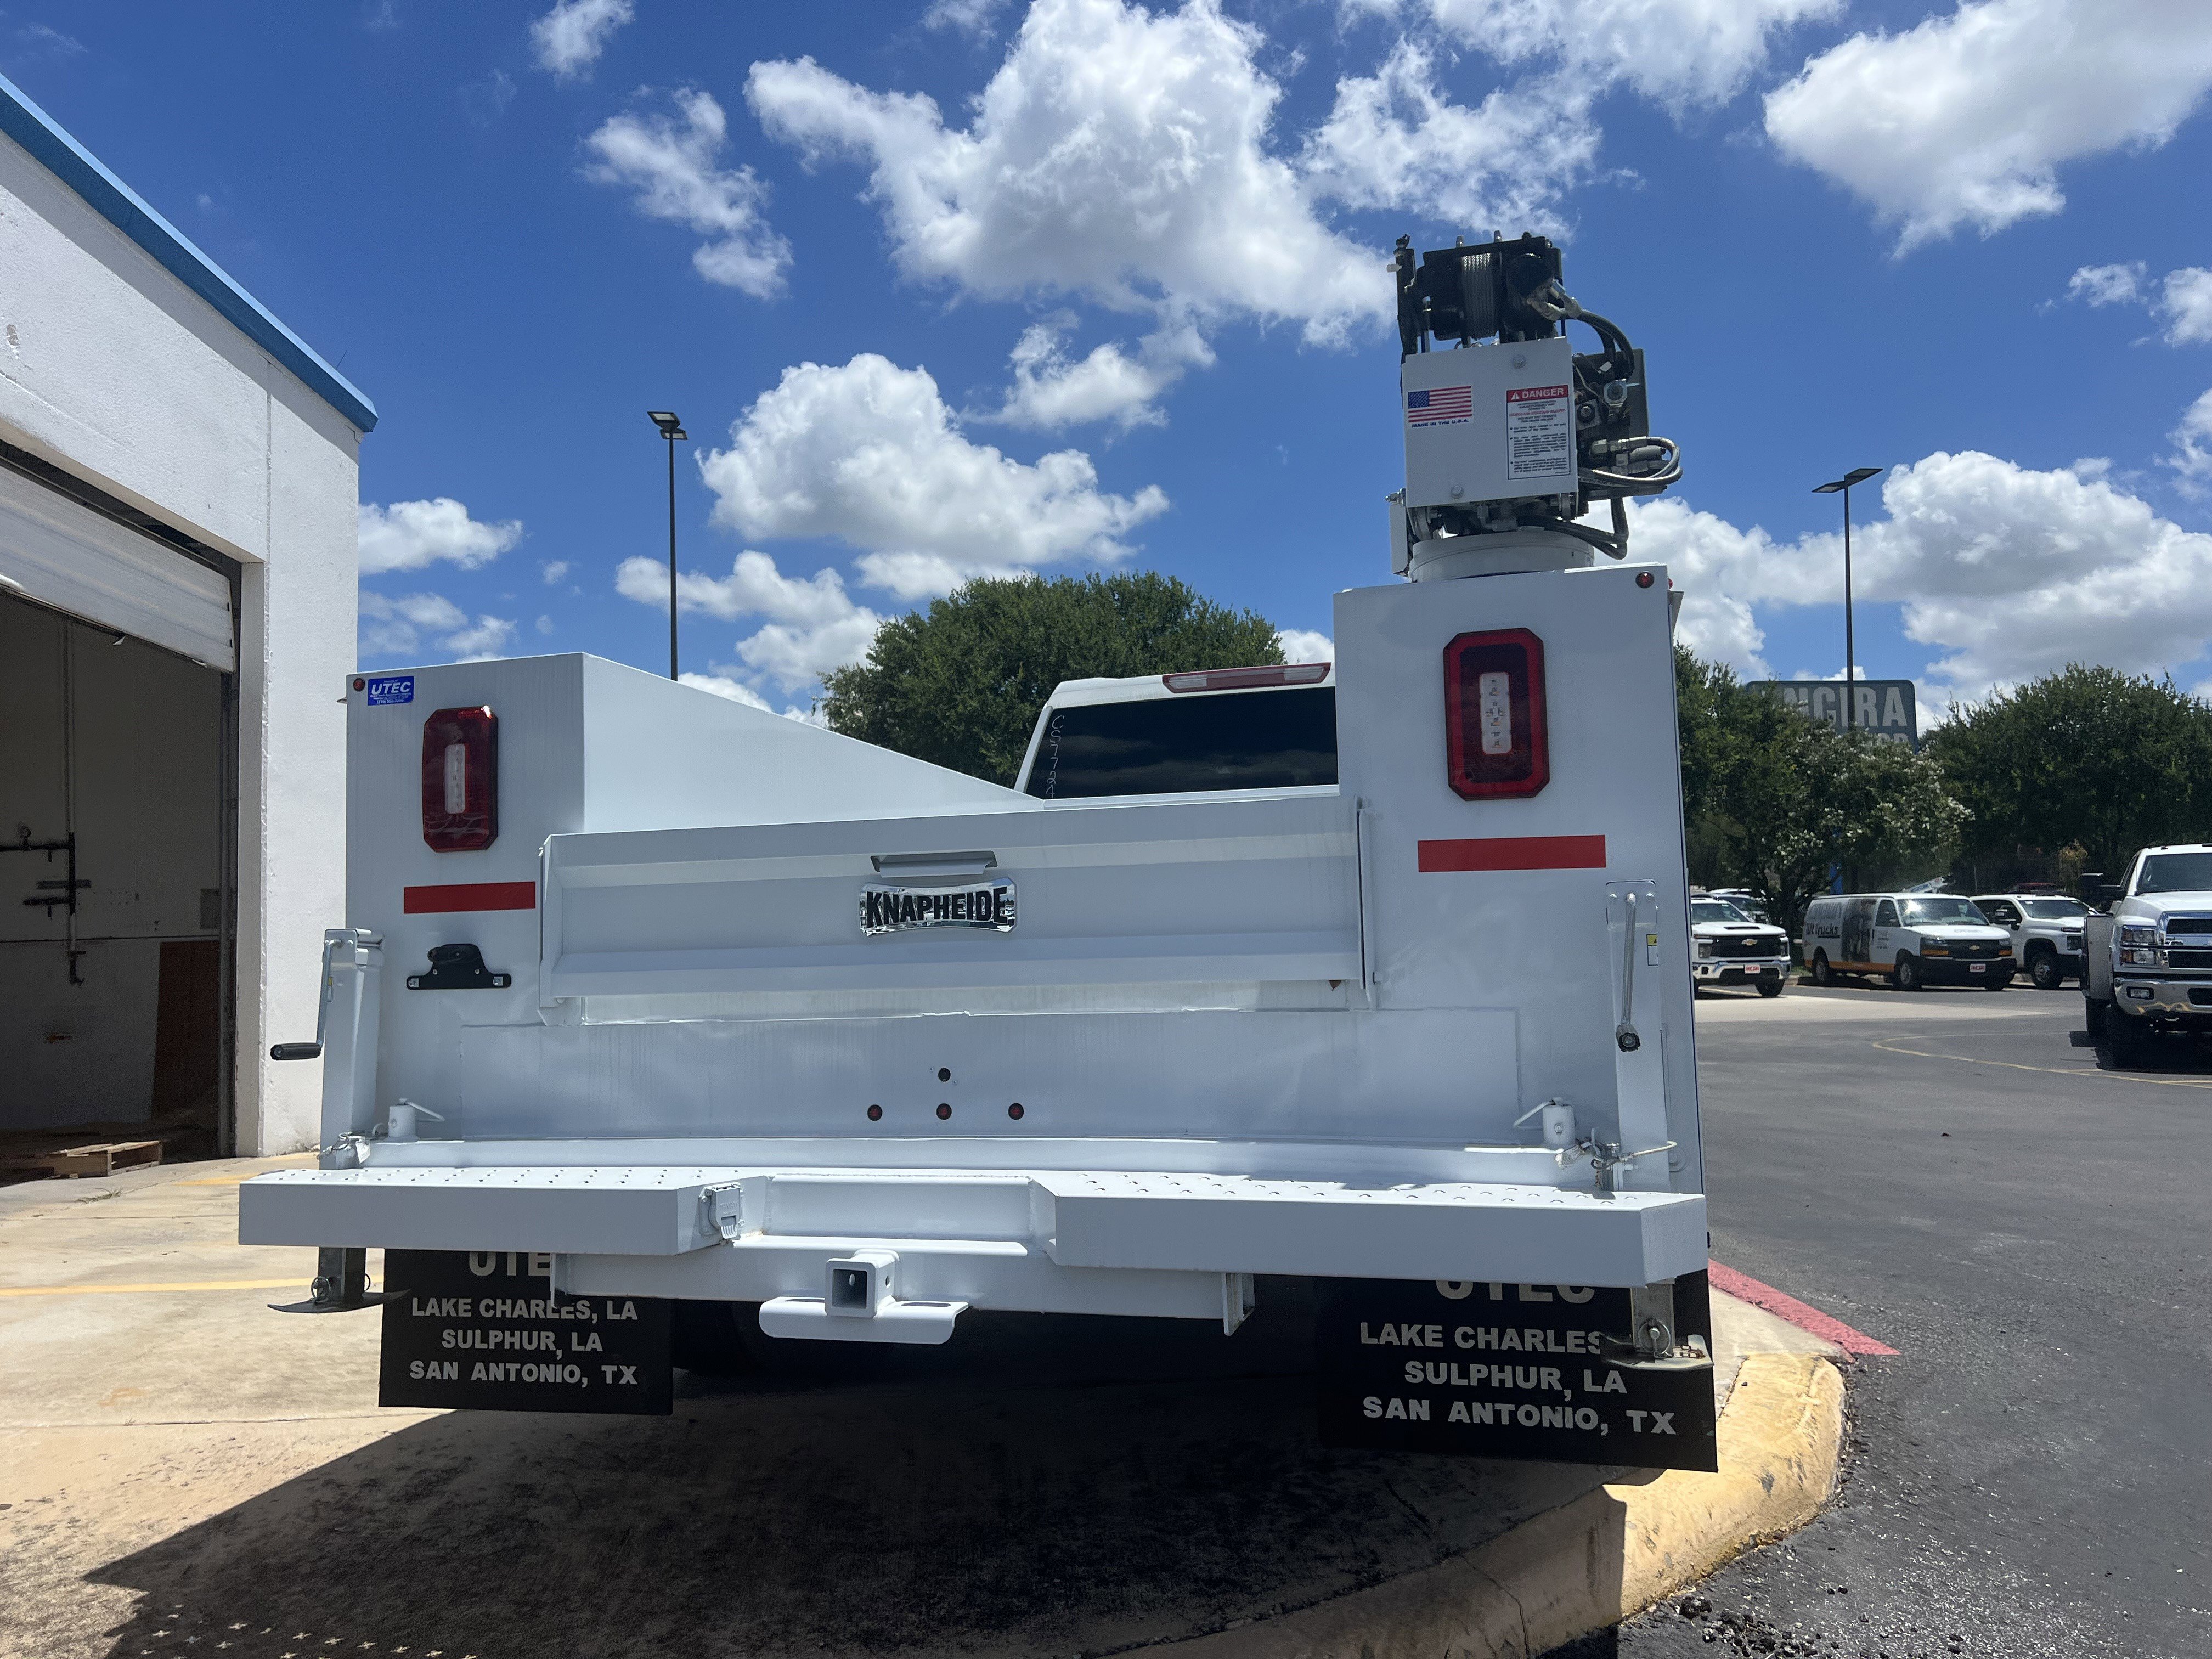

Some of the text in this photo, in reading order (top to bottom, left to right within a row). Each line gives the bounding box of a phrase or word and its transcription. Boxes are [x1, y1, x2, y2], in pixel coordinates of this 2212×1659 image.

[1522, 388, 1564, 399] DANGER
[371, 681, 411, 695] UTEC
[1783, 686, 1908, 727] NCIRA
[866, 887, 1008, 928] KNAPHEIDE
[413, 1297, 637, 1324] LAKE CHARLES, LA
[442, 1330, 603, 1361] SULPHUR, LA
[1361, 1322, 1443, 1348] LAKE
[410, 1361, 637, 1388] SAN ANTONIO, TX
[1404, 1361, 1627, 1402] SULPHUR, LA
[1363, 1396, 1676, 1436] SAN ANTONIO, TX
